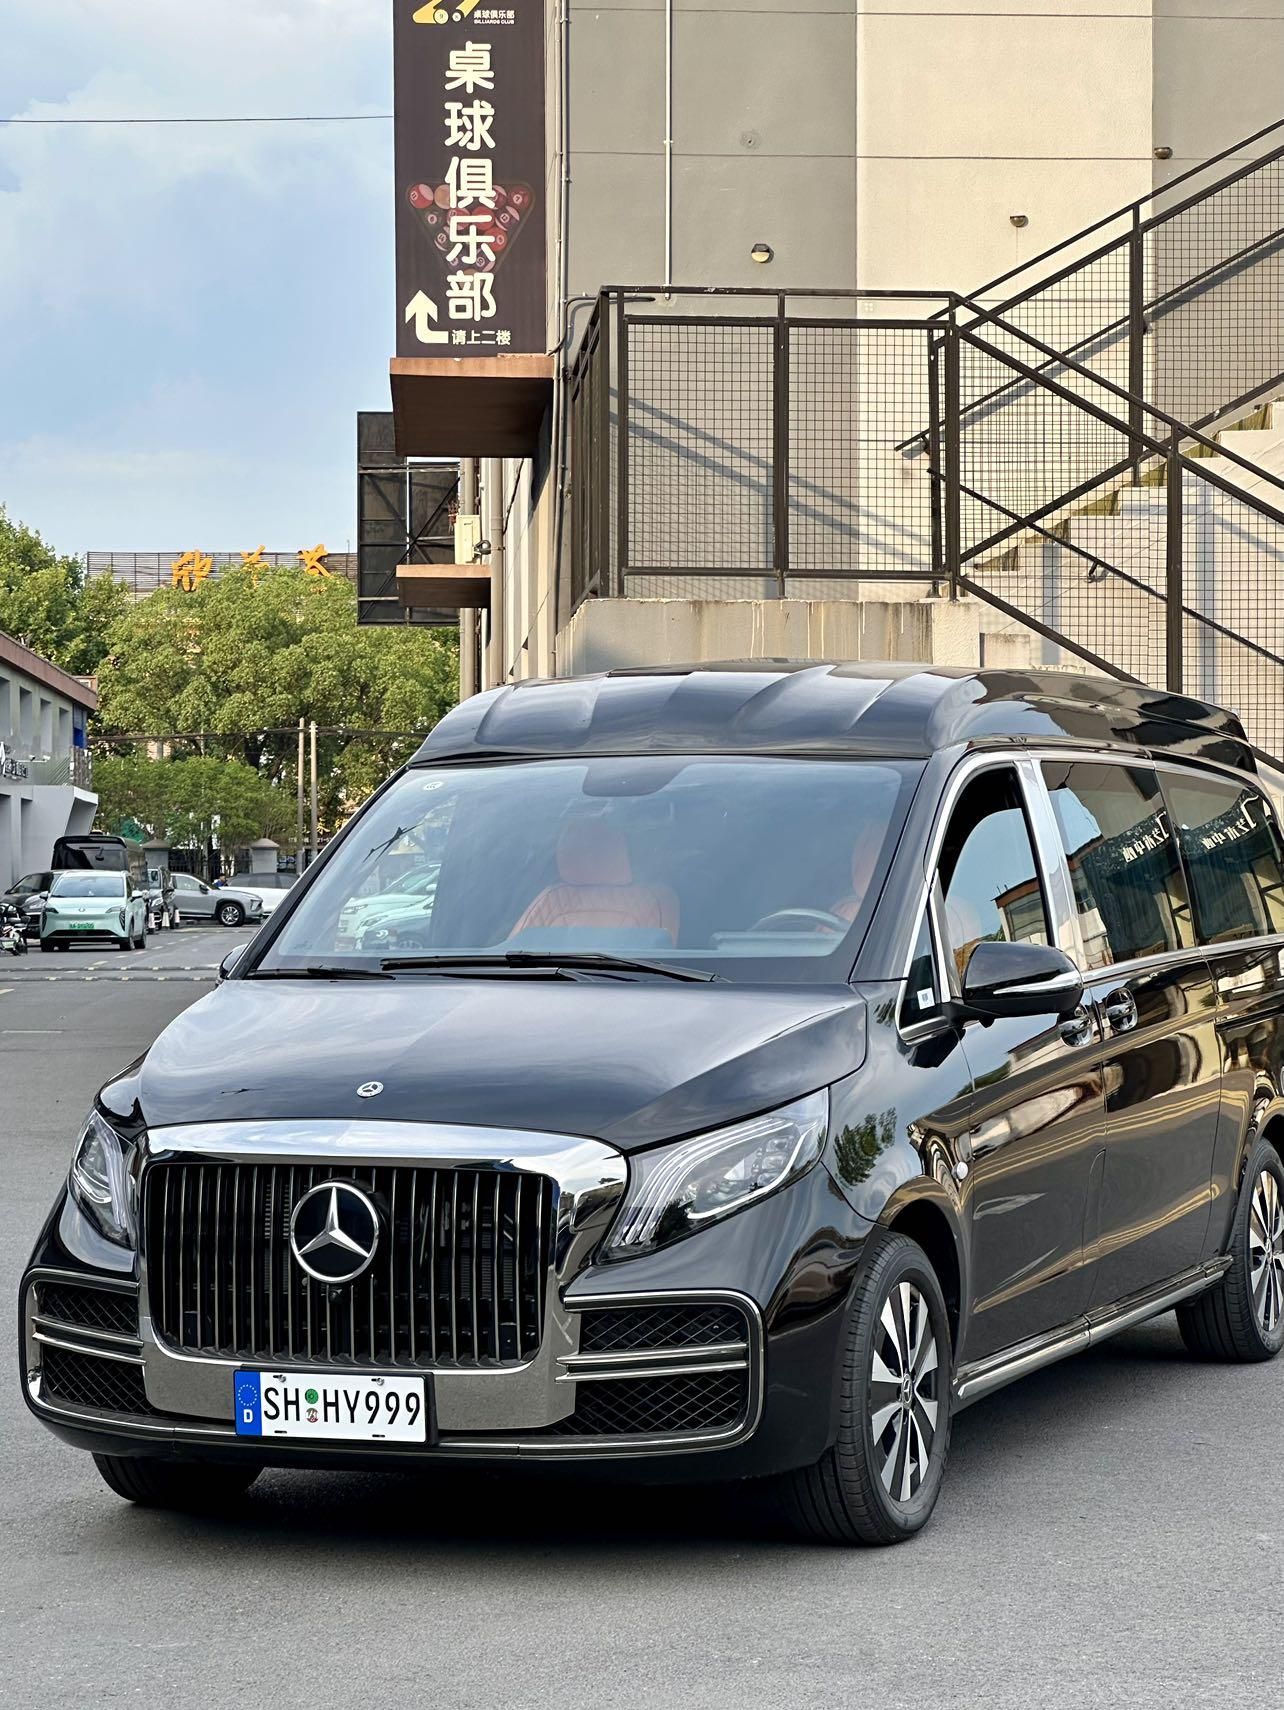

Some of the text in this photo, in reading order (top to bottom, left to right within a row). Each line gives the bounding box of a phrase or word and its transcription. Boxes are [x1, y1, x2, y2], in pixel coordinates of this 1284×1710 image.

[473, 9, 515, 19] 桌球俱乐部
[445, 41, 497, 321] 桌球俱乐部
[451, 329, 512, 346] 请上二楼
[243, 1408, 254, 1423] D
[323, 1389, 421, 1426] HY999
